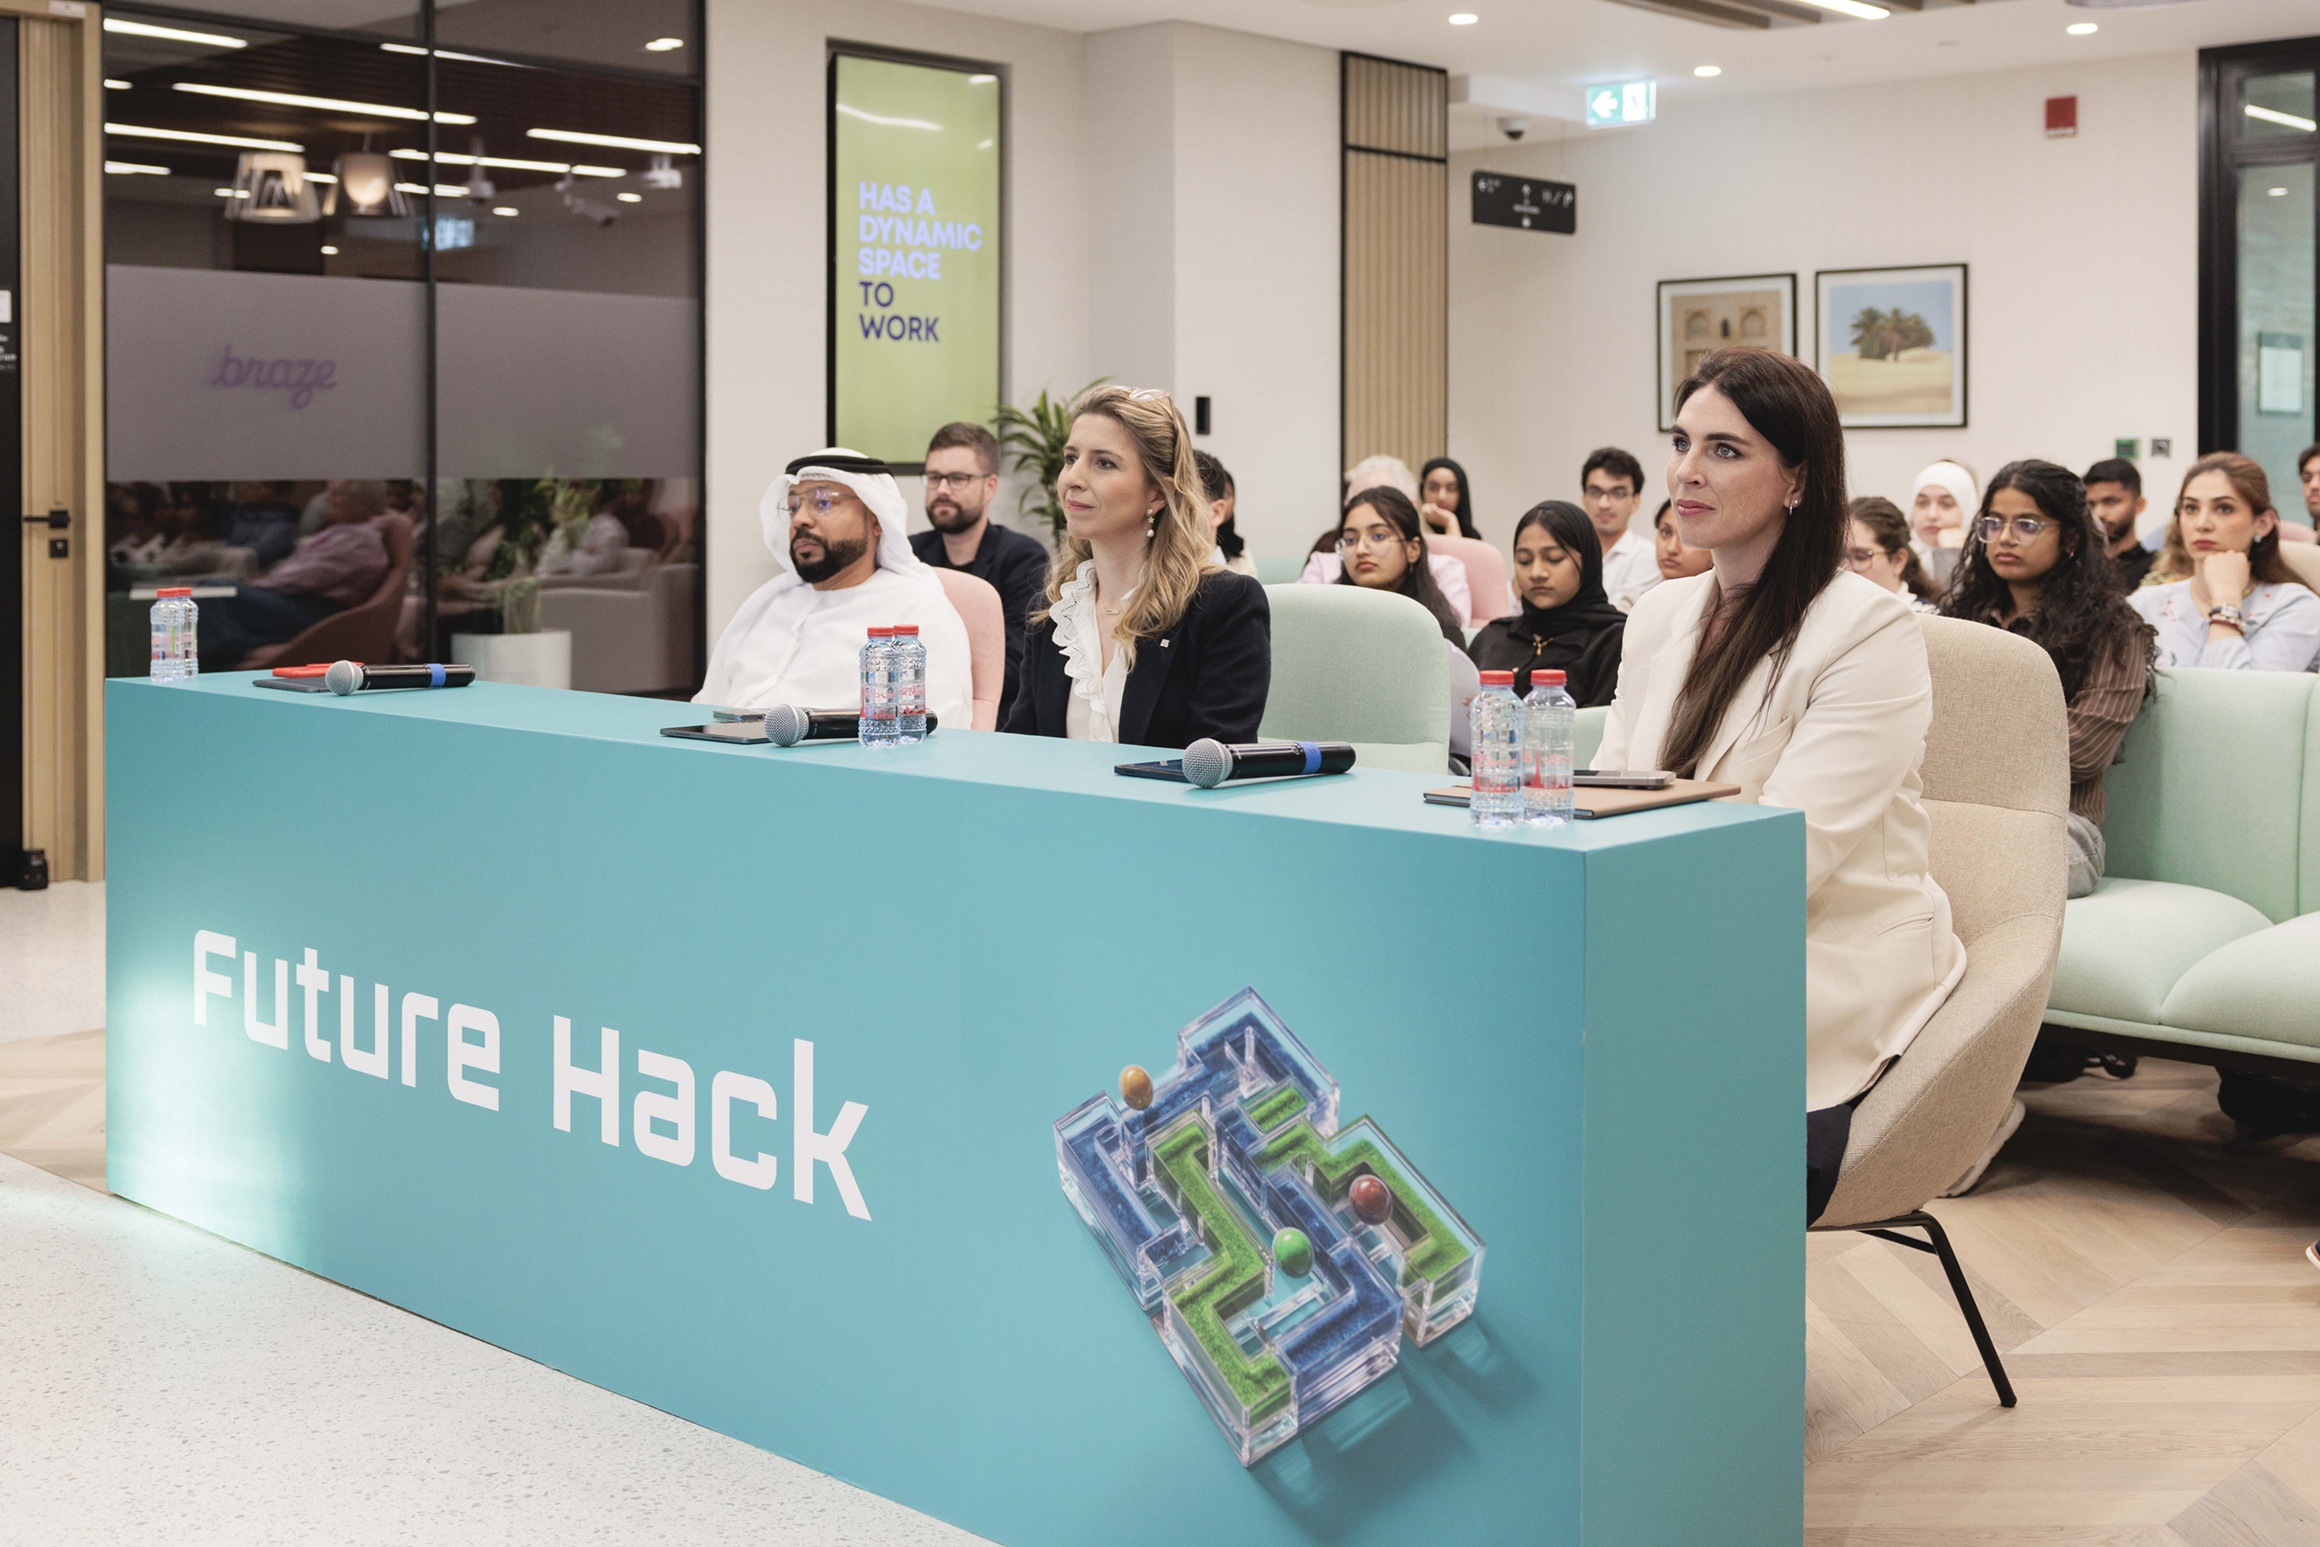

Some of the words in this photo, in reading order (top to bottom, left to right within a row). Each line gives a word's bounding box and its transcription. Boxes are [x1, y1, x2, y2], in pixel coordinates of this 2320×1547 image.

[858, 181, 912, 213] HAS
[916, 187, 935, 215] A
[858, 214, 982, 251] DYNAMIC
[858, 246, 941, 280] SPACE
[859, 281, 894, 308] TO
[859, 314, 940, 342] WORK
[209, 343, 338, 411] braze
[193, 929, 501, 1112] Future
[553, 1014, 873, 1222] Hack
